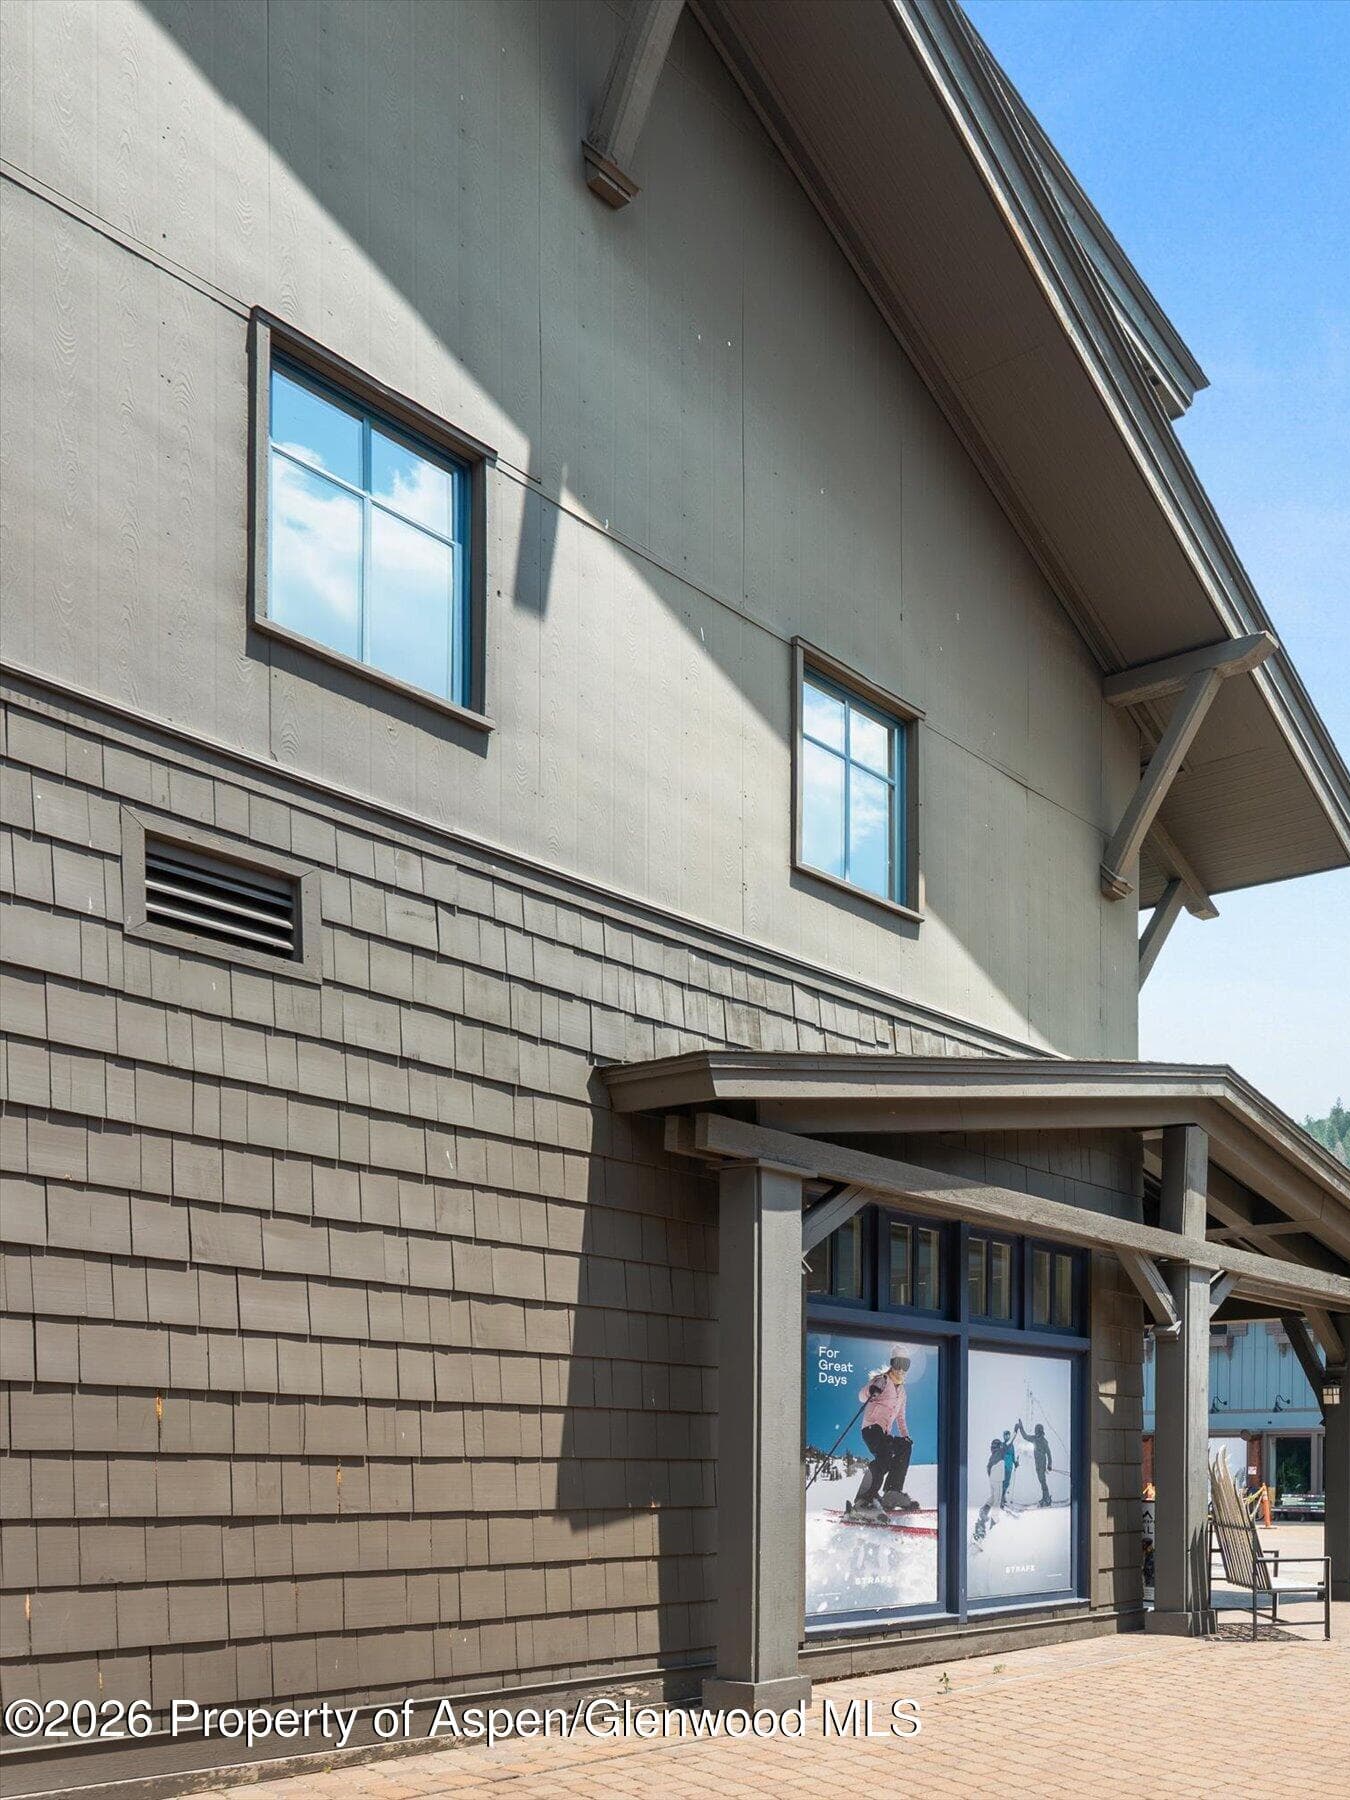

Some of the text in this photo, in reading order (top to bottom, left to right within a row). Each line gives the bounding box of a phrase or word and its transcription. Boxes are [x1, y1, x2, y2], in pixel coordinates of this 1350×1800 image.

[819, 1346, 840, 1358] For
[819, 1359, 854, 1372] Great
[818, 1372, 847, 1386] Days
